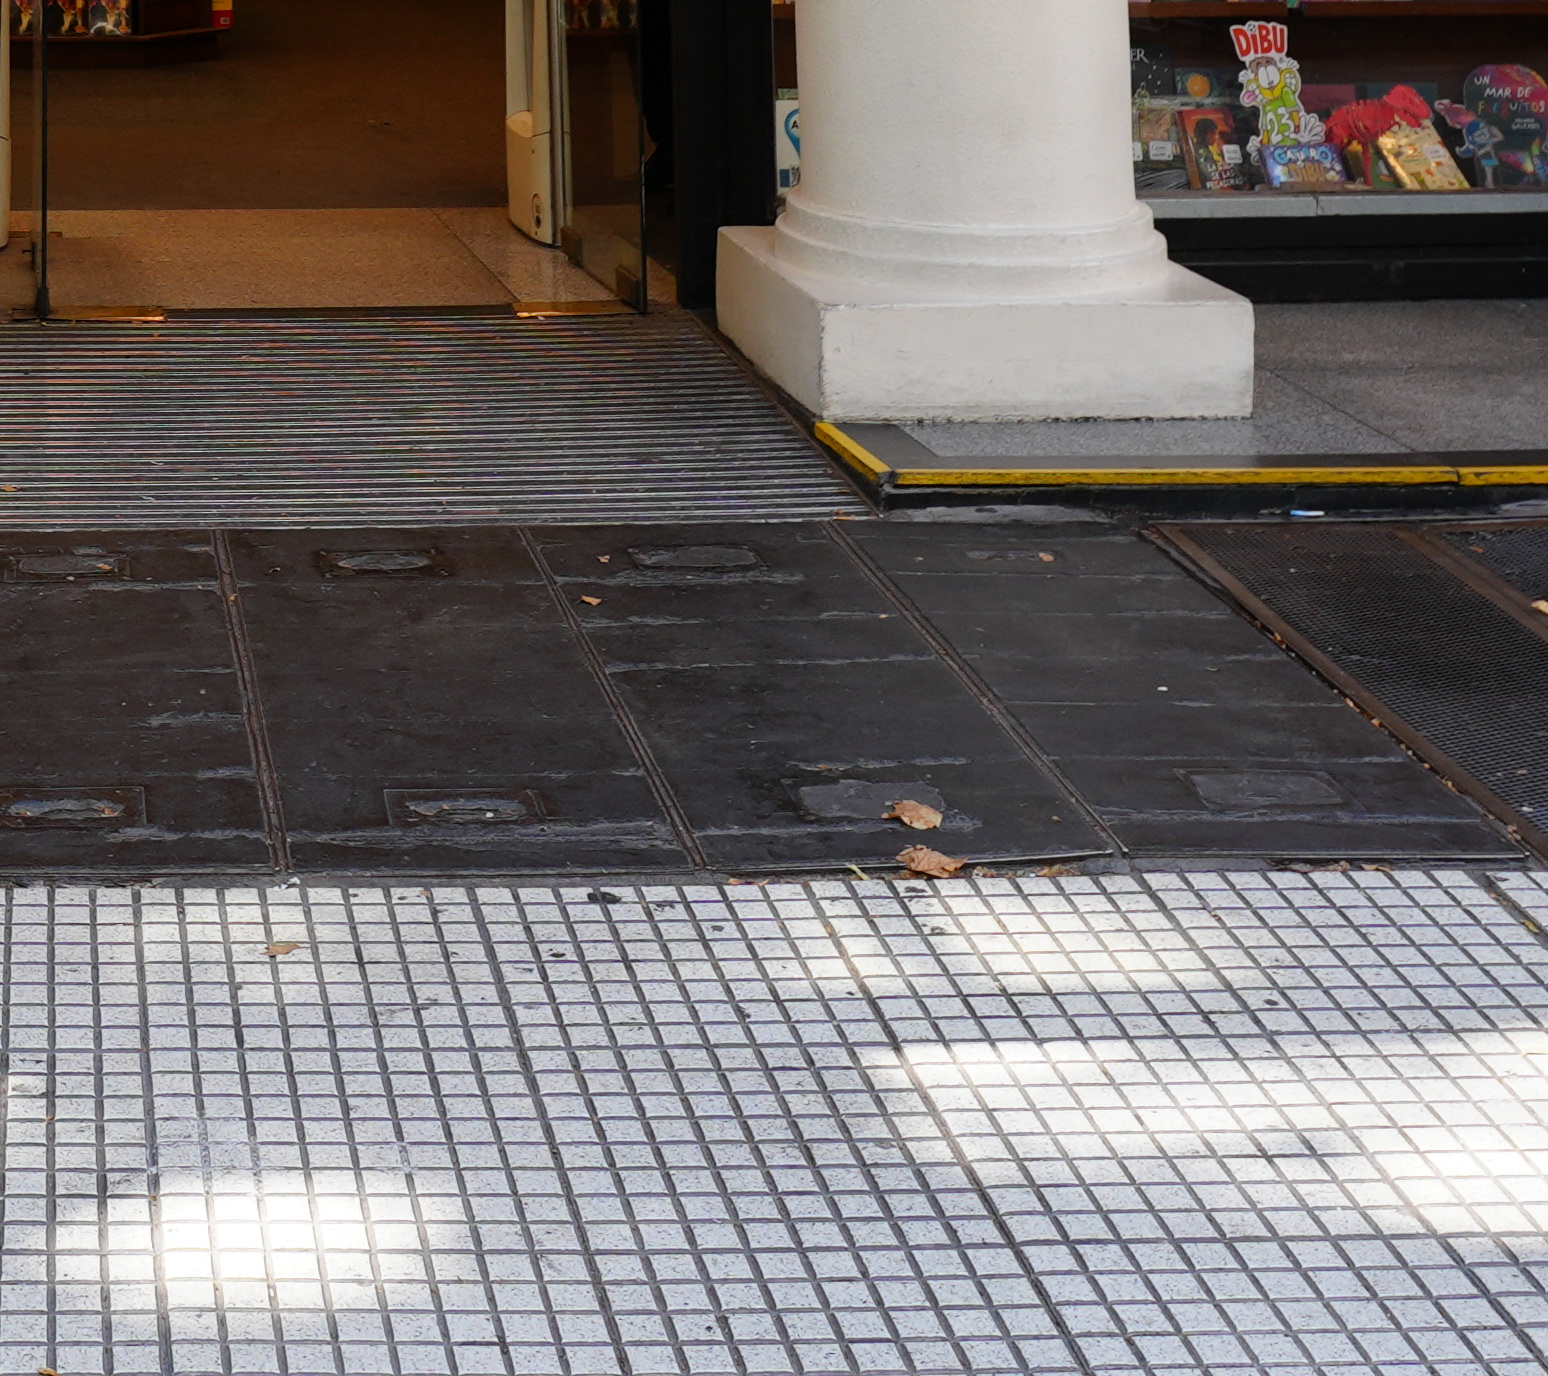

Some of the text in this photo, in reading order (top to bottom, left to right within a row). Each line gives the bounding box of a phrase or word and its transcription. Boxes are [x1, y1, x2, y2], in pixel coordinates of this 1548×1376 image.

[1473, 73, 1492, 86] UN
[1483, 87, 1534, 98] MAR DE
